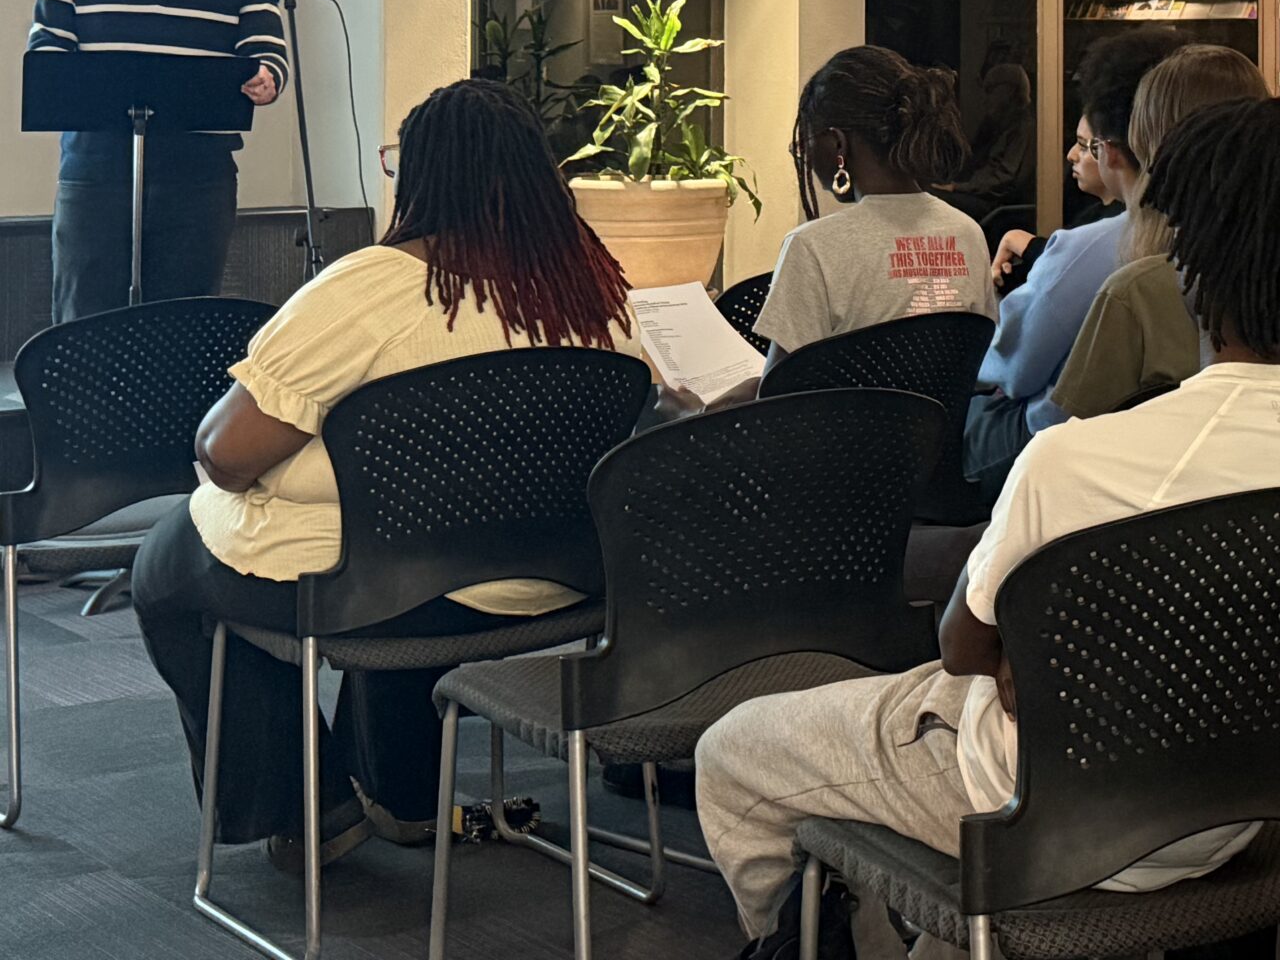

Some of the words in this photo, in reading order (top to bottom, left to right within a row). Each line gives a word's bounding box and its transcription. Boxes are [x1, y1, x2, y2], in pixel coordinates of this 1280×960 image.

[927, 236, 944, 251] ALL
[946, 236, 956, 251] IN
[888, 253, 914, 268] THIS
[915, 252, 966, 267] TOGETHER
[902, 268, 929, 278] MUSICAL
